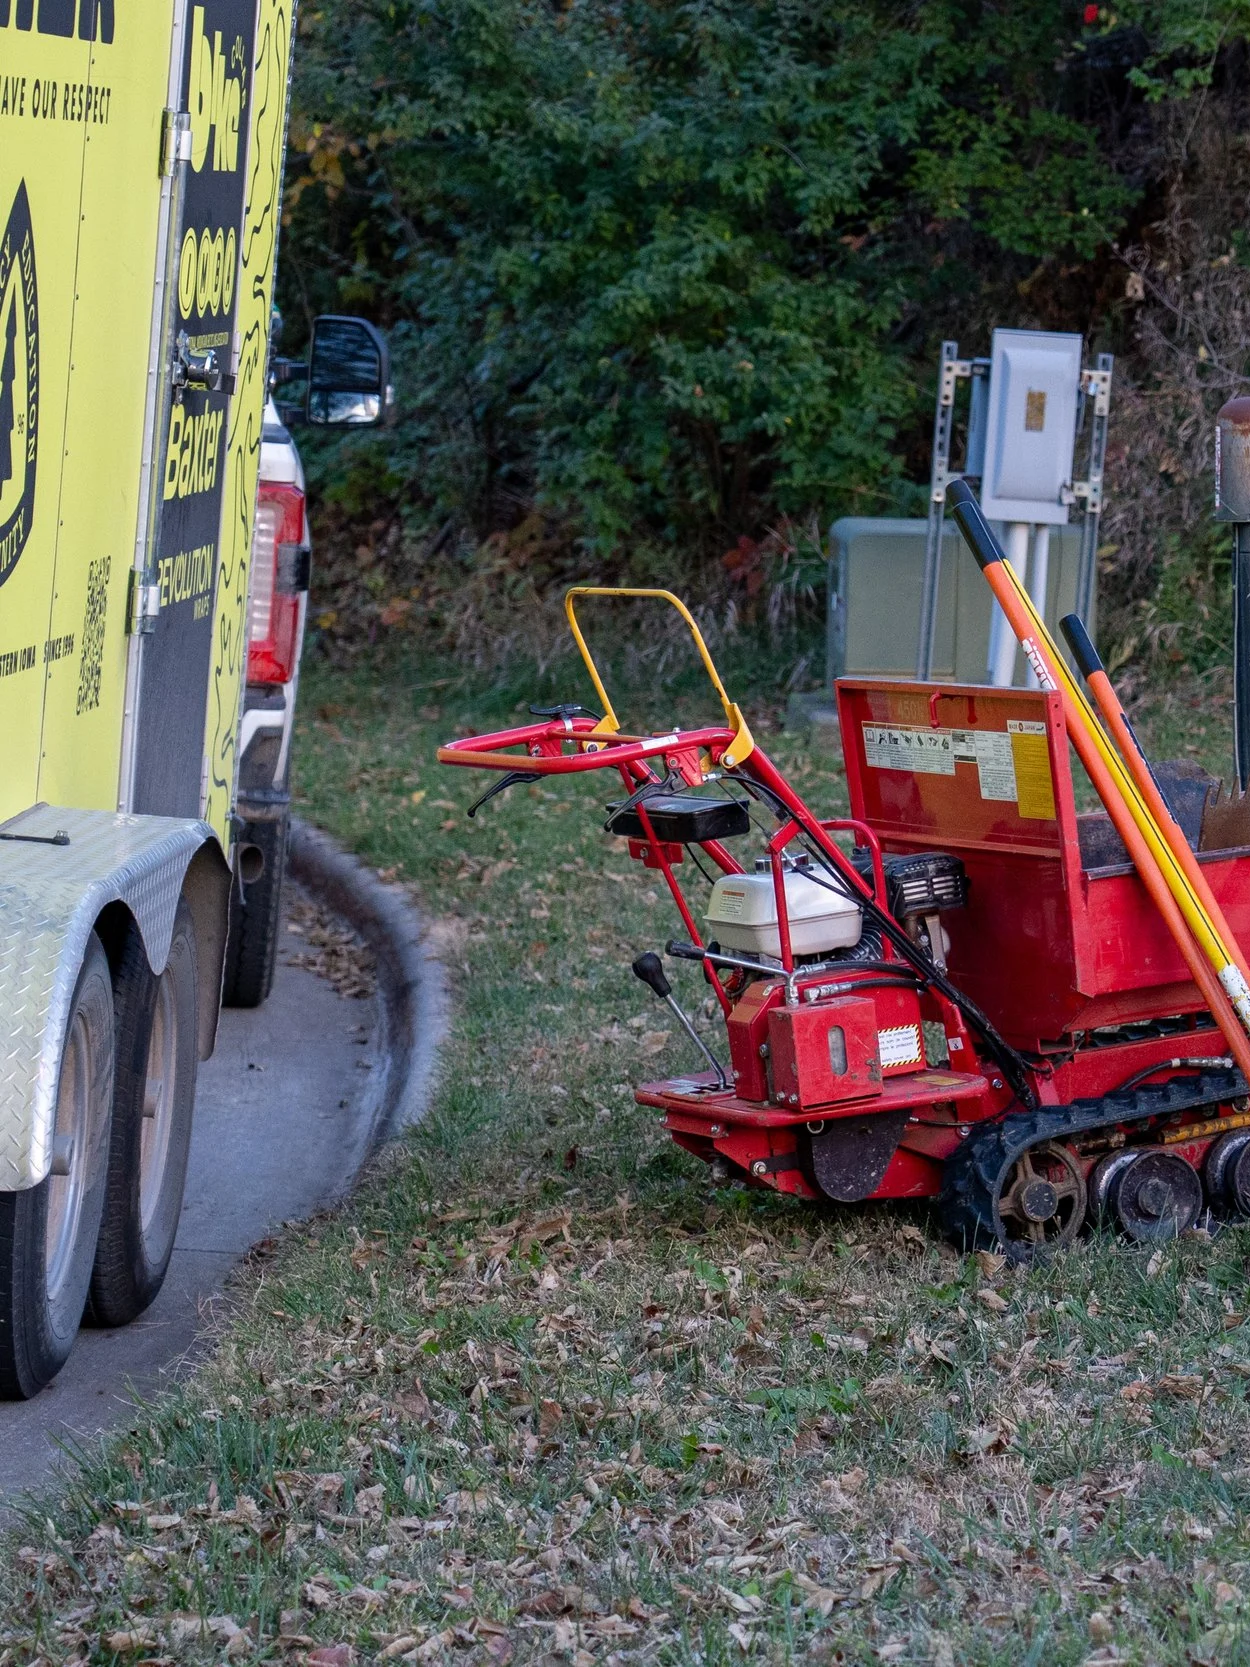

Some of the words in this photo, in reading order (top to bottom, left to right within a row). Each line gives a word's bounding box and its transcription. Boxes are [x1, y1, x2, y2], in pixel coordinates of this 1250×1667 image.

[0, 75, 26, 116] AVE
[32, 78, 58, 119] OUR
[62, 83, 111, 125] RESPECT
[22, 229, 37, 463] EDUCATION
[163, 398, 224, 501] Baxter
[0, 506, 25, 573] NITY
[19, 644, 36, 672] IOWA
[43, 636, 62, 664] SINCE
